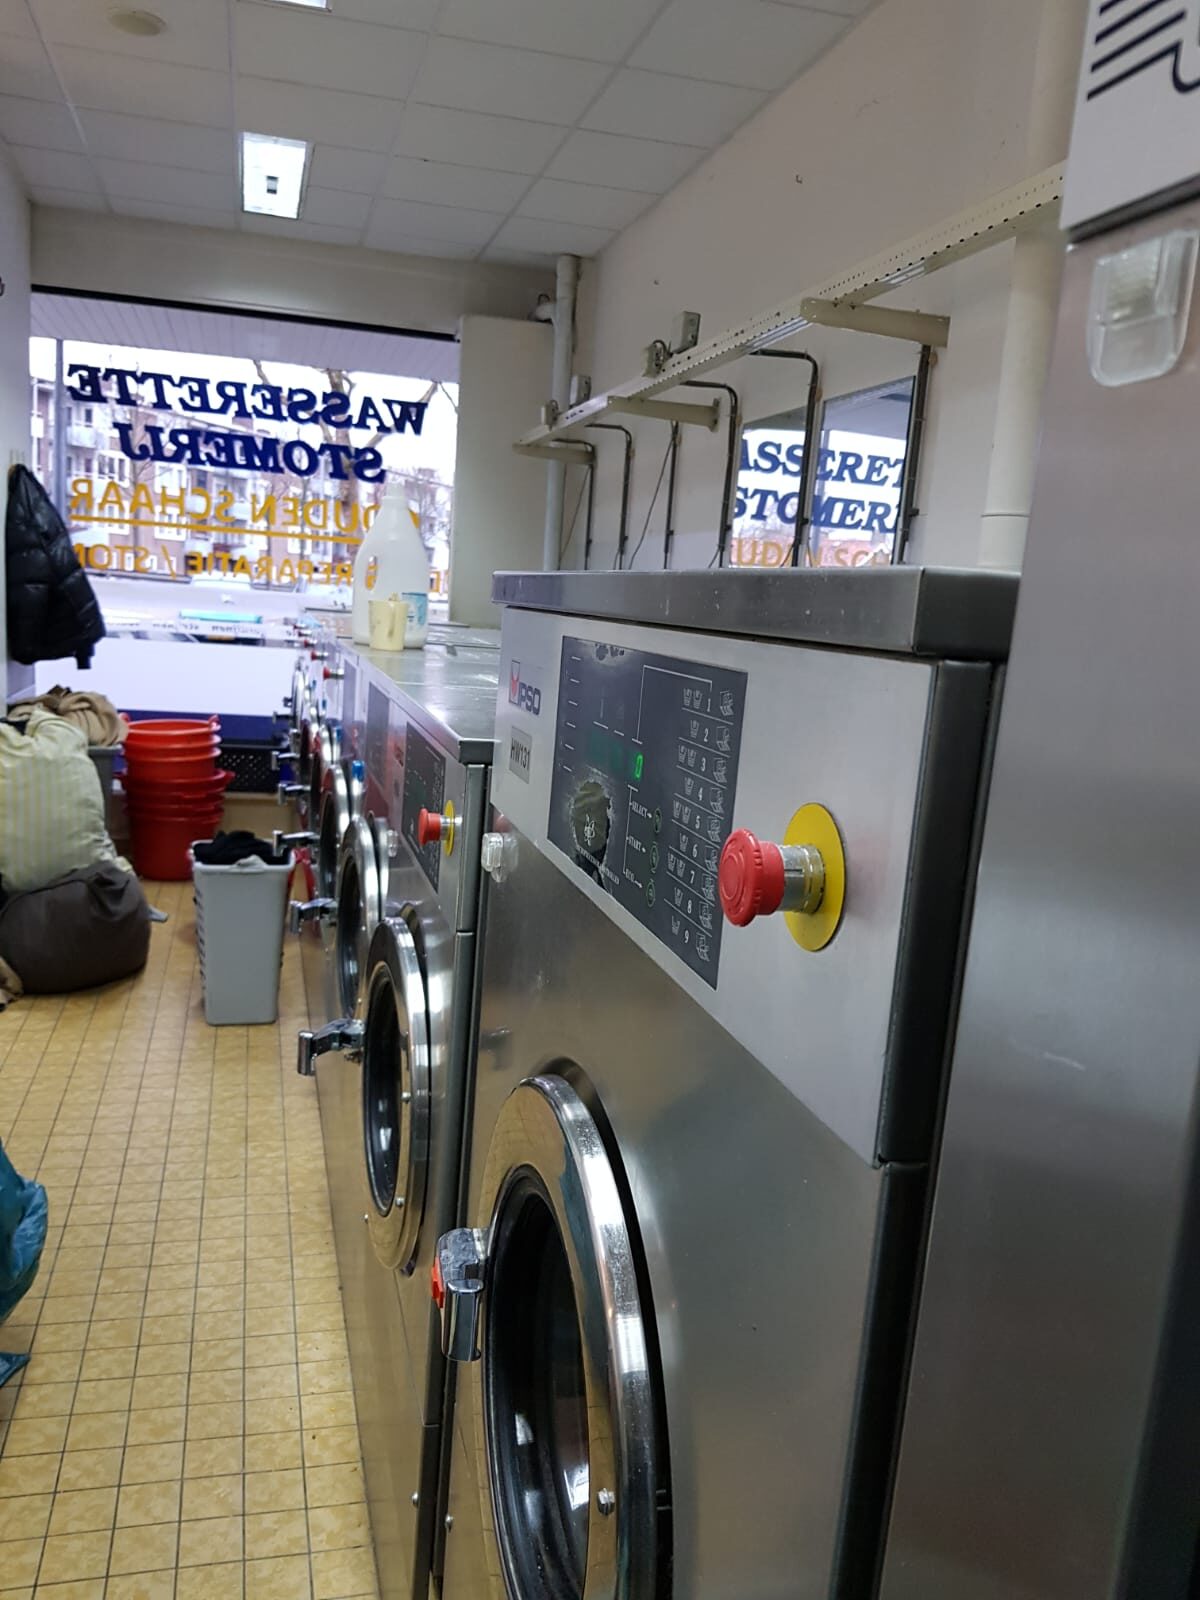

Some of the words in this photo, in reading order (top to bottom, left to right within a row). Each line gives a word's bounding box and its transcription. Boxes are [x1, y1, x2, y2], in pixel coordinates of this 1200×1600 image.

[706, 698, 711, 712] 1
[703, 727, 709, 742] 2
[510, 737, 530, 771] HW131
[635, 753, 644, 780] 0
[700, 757, 706, 772] 3
[698, 787, 703, 801] 4
[631, 801, 648, 819] SELECT
[694, 815, 701, 829] 5
[627, 835, 642, 851] START
[692, 844, 698, 858] 6
[689, 870, 695, 884] 7
[687, 900, 692, 914] 8
[684, 930, 690, 944] 9
